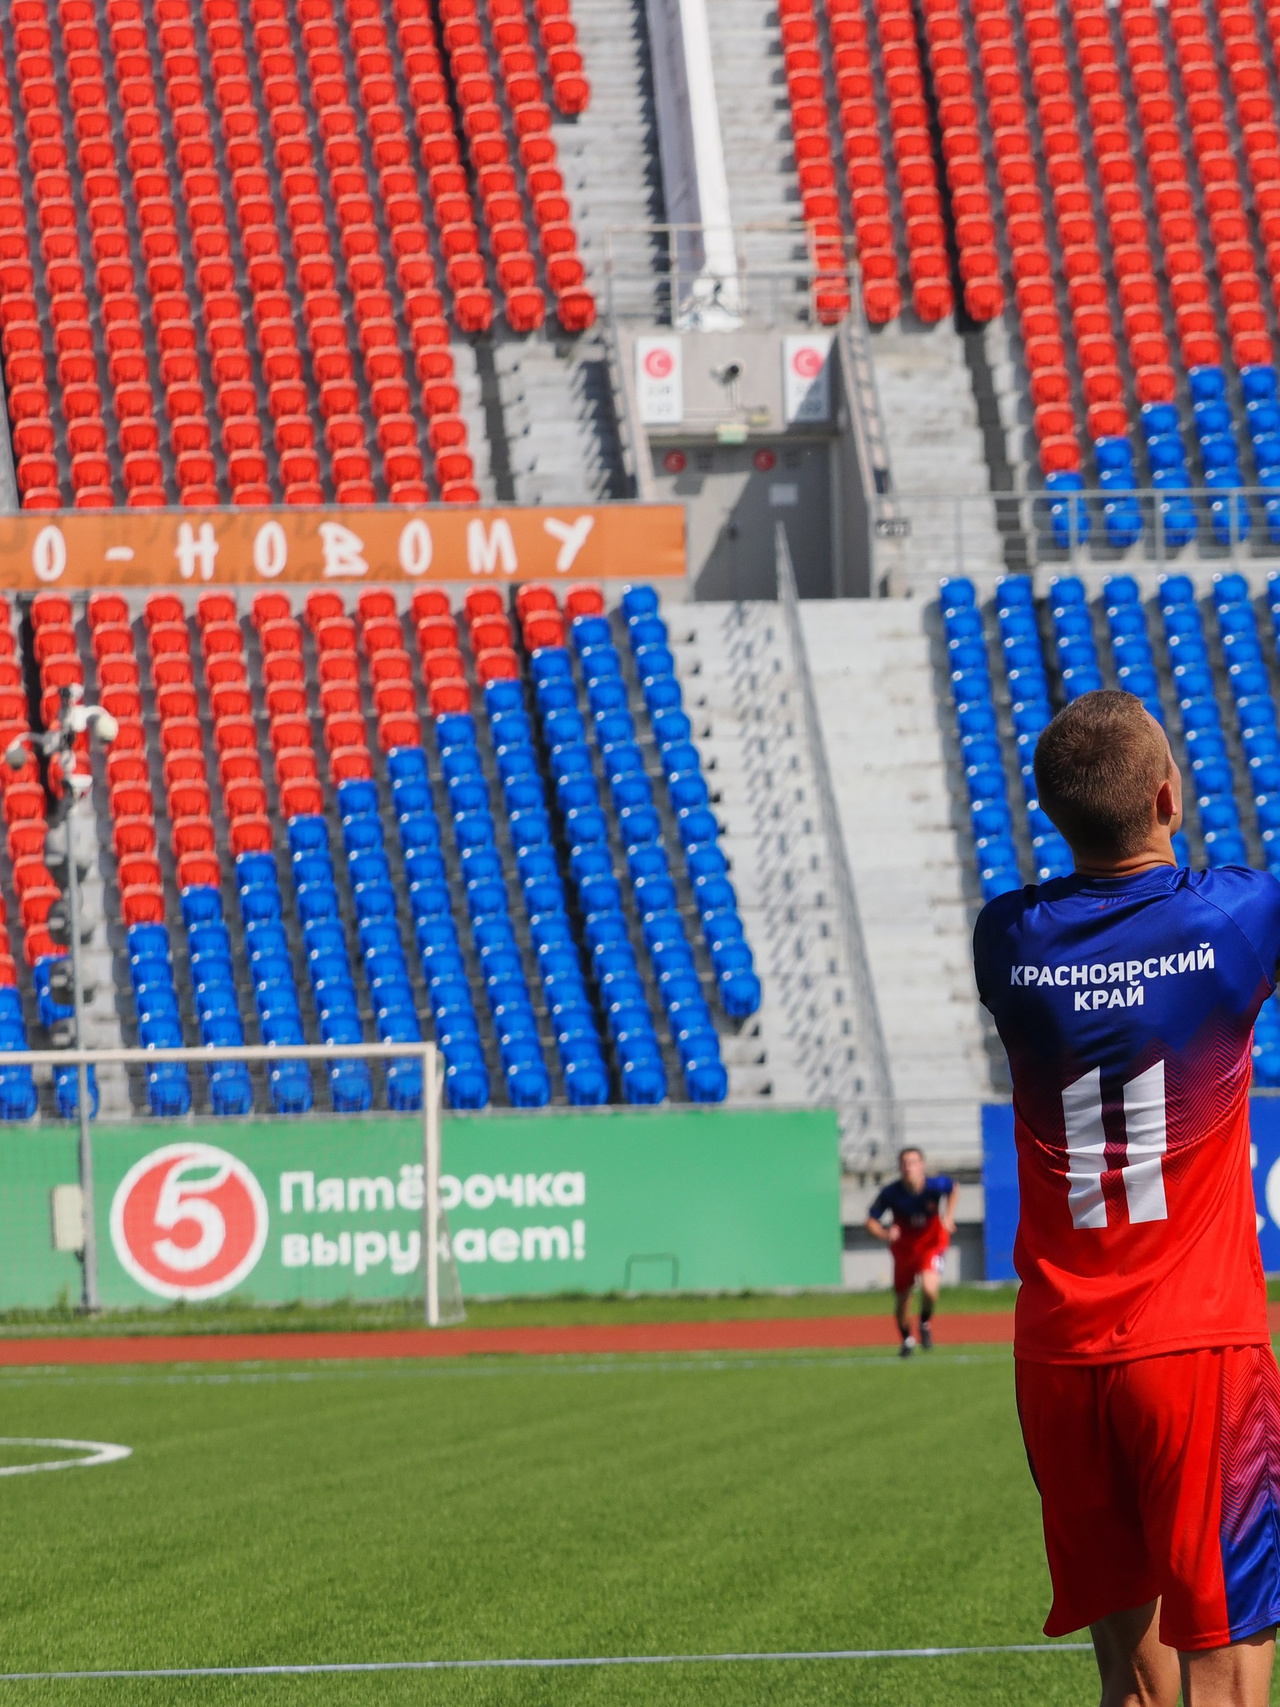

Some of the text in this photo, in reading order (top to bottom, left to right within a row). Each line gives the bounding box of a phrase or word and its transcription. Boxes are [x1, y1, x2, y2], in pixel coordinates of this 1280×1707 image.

[1010, 942, 1215, 987] КРАСНОЯРСКИЙ
[1074, 980, 1145, 1011] КРАЙ
[1061, 1058, 1168, 1230] 11
